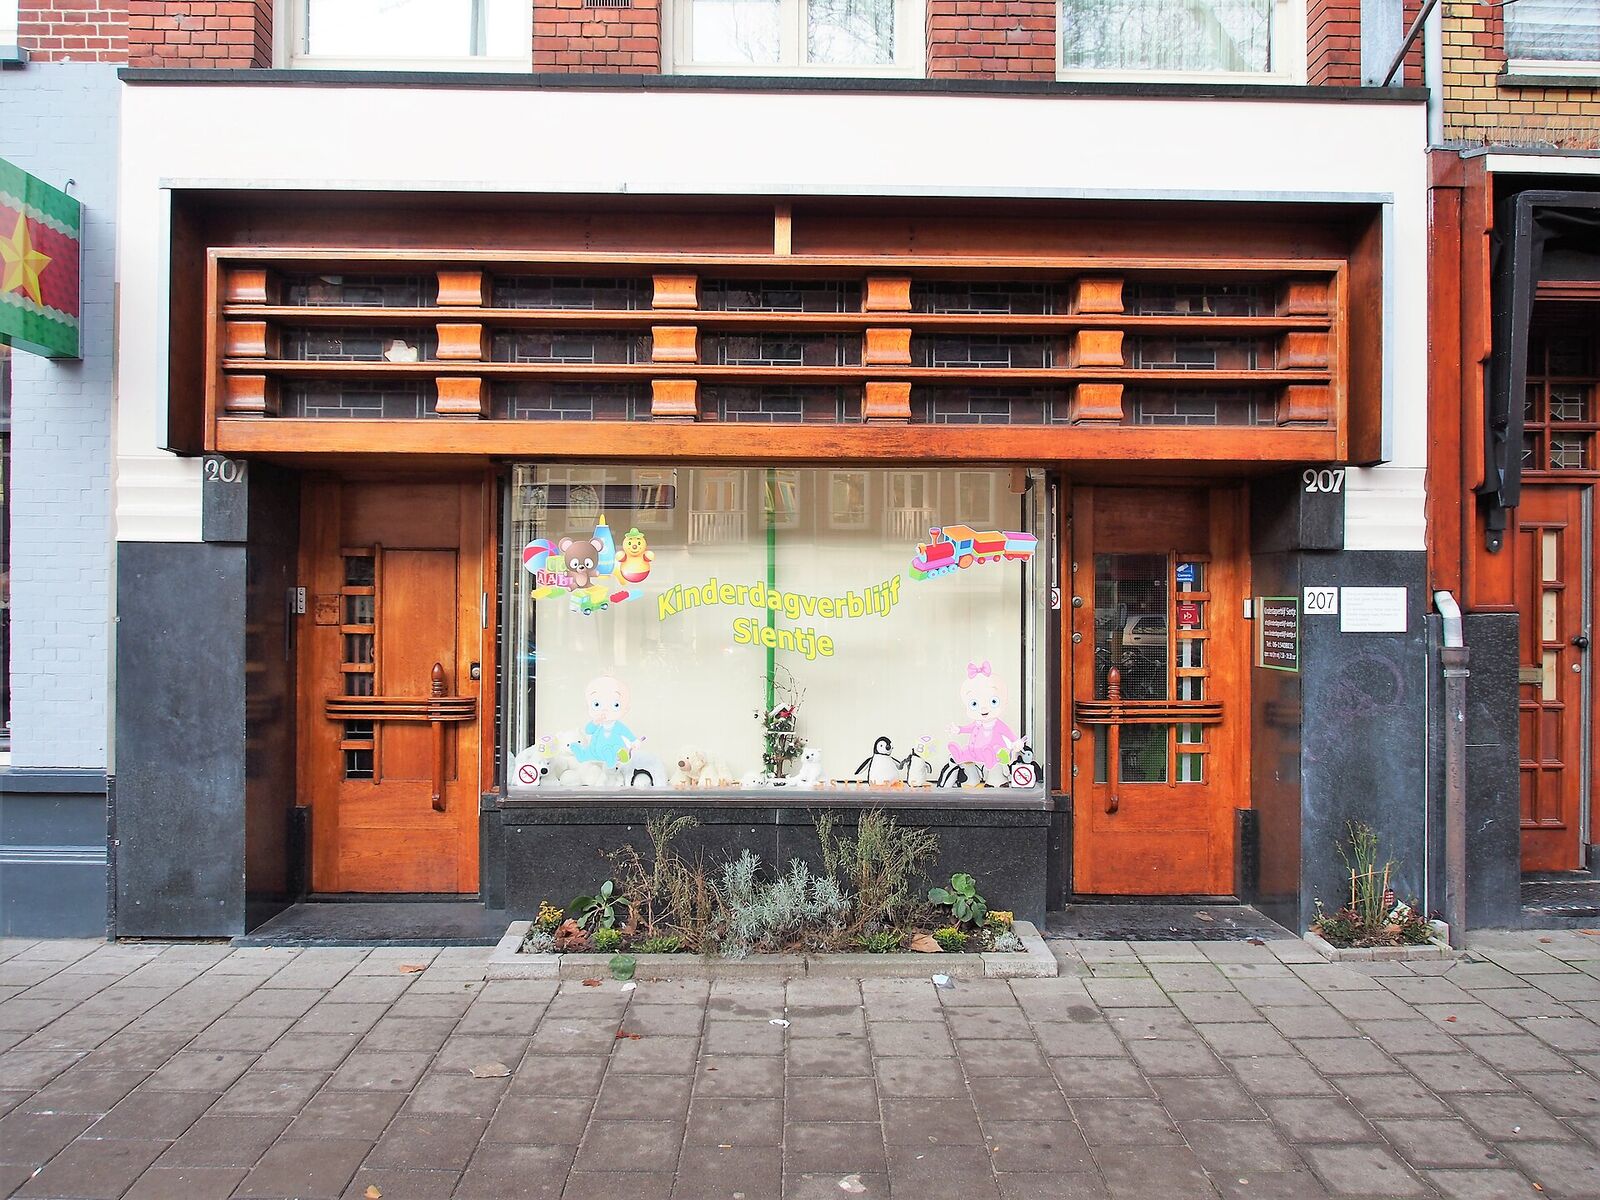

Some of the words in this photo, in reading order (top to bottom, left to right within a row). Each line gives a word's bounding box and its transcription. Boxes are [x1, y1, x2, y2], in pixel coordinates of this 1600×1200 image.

[204, 459, 247, 482] 207
[1303, 468, 1345, 492] 207
[657, 574, 900, 621] Kinderdagverblijf
[1307, 592, 1335, 609] 207
[732, 617, 835, 661] Sientje
